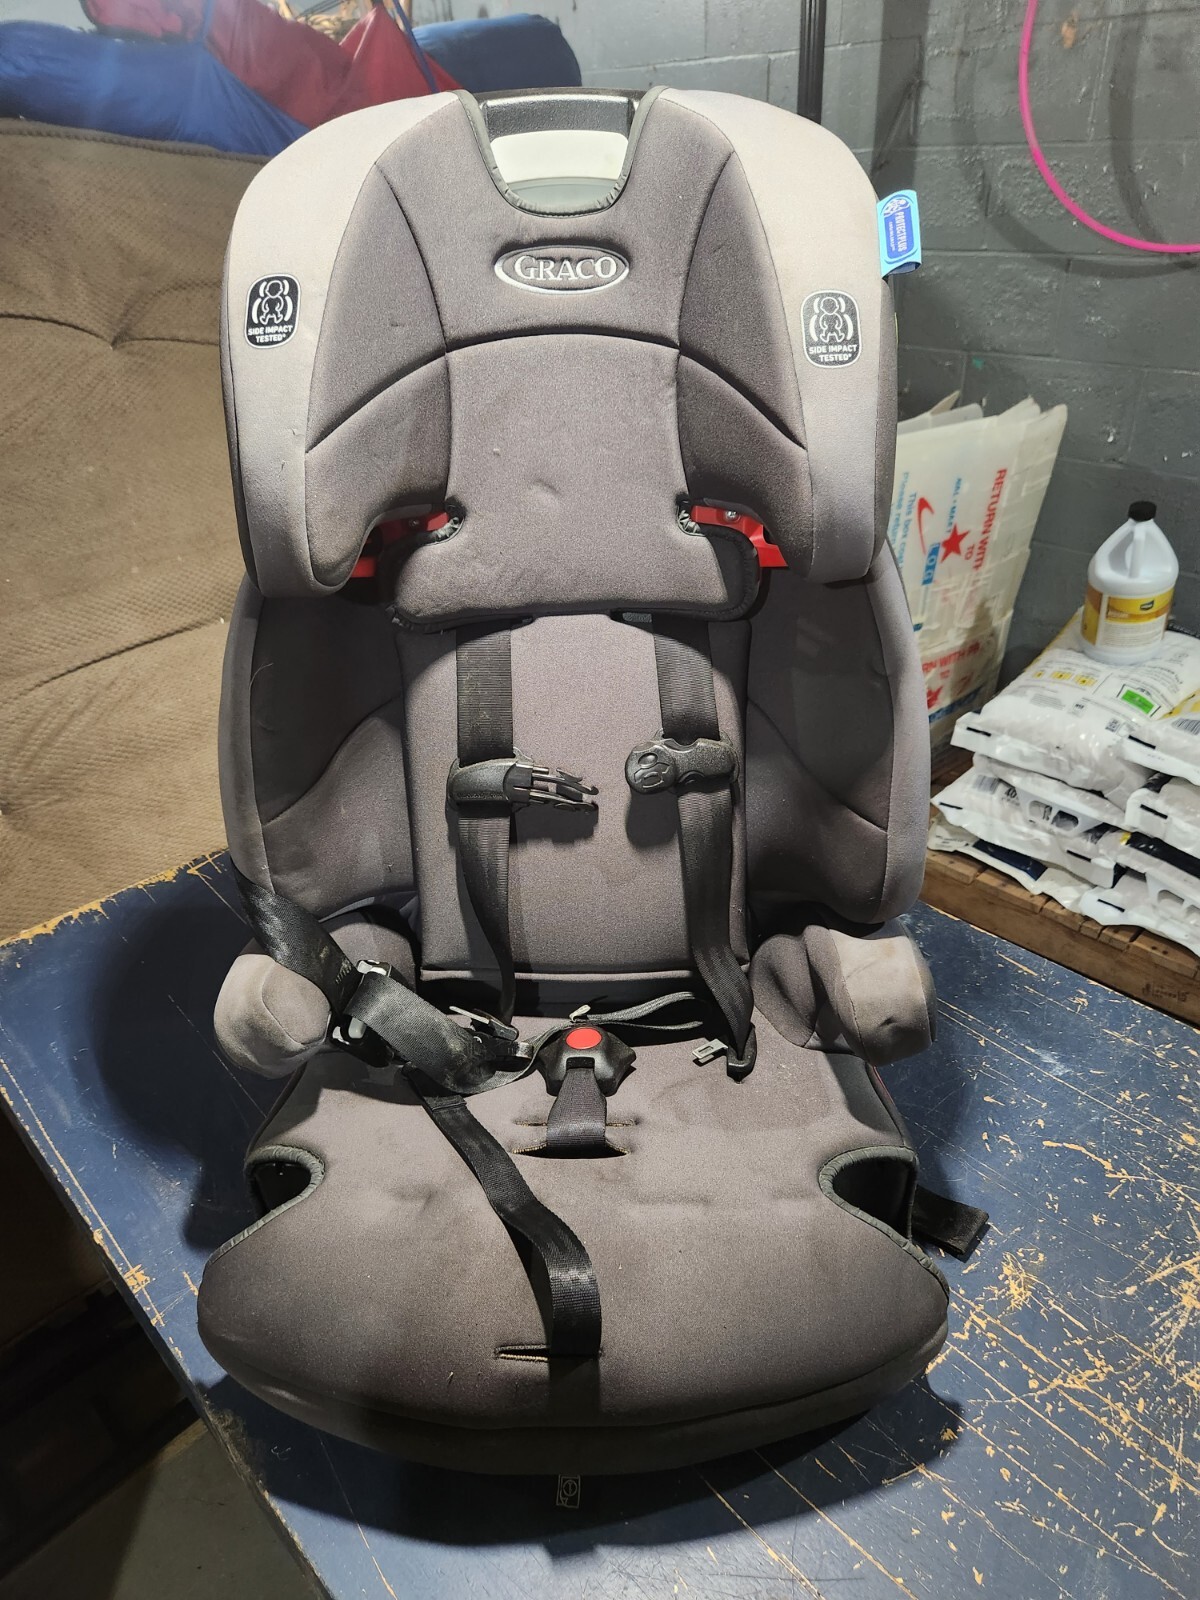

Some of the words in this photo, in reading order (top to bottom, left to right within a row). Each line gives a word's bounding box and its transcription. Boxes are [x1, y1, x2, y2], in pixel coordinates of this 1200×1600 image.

[514, 255, 617, 280] GRACO
[248, 327, 264, 336] SIDE
[265, 325, 293, 334] IMPACT
[808, 346, 827, 355] SIDE
[828, 344, 858, 353] IMPACT
[905, 492, 917, 516] This
[982, 468, 1007, 534] RETURN
[902, 519, 912, 539] box
[964, 545, 975, 561] TO
